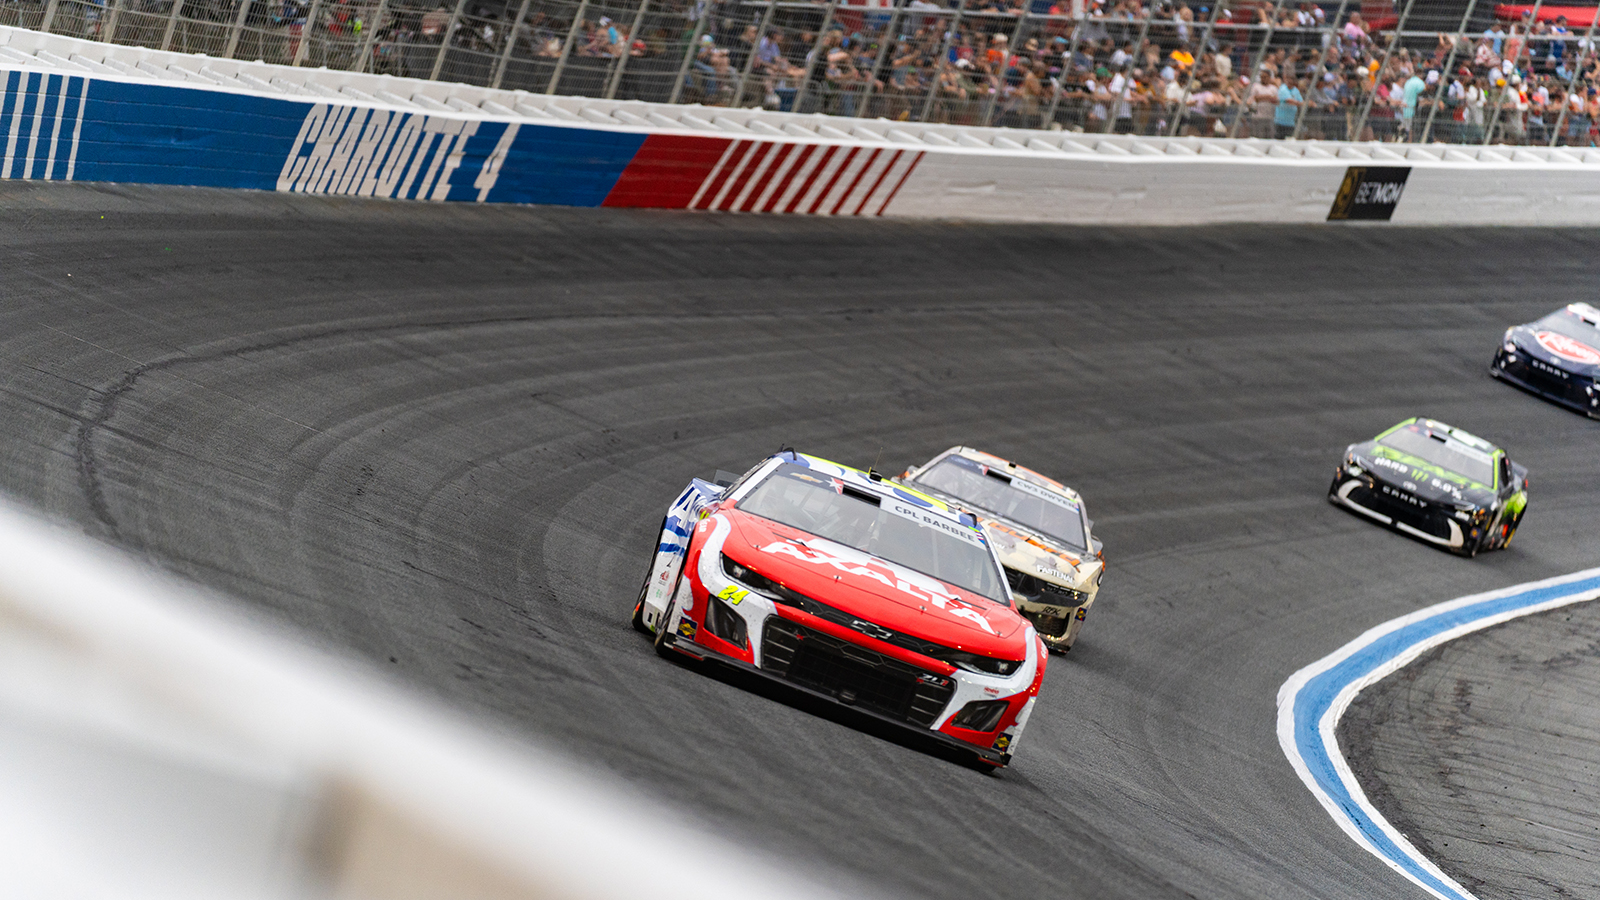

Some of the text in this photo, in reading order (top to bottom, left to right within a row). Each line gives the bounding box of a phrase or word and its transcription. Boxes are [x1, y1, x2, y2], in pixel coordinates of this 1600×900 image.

[276, 103, 521, 203] CHARLOTTE 4
[1354, 181, 1406, 205] BETMGM
[1382, 485, 1428, 509] CAMRY
[894, 505, 920, 520] CPL
[922, 516, 976, 543] BARBEE
[717, 584, 751, 606] 24
[759, 541, 997, 635] AXALTA
